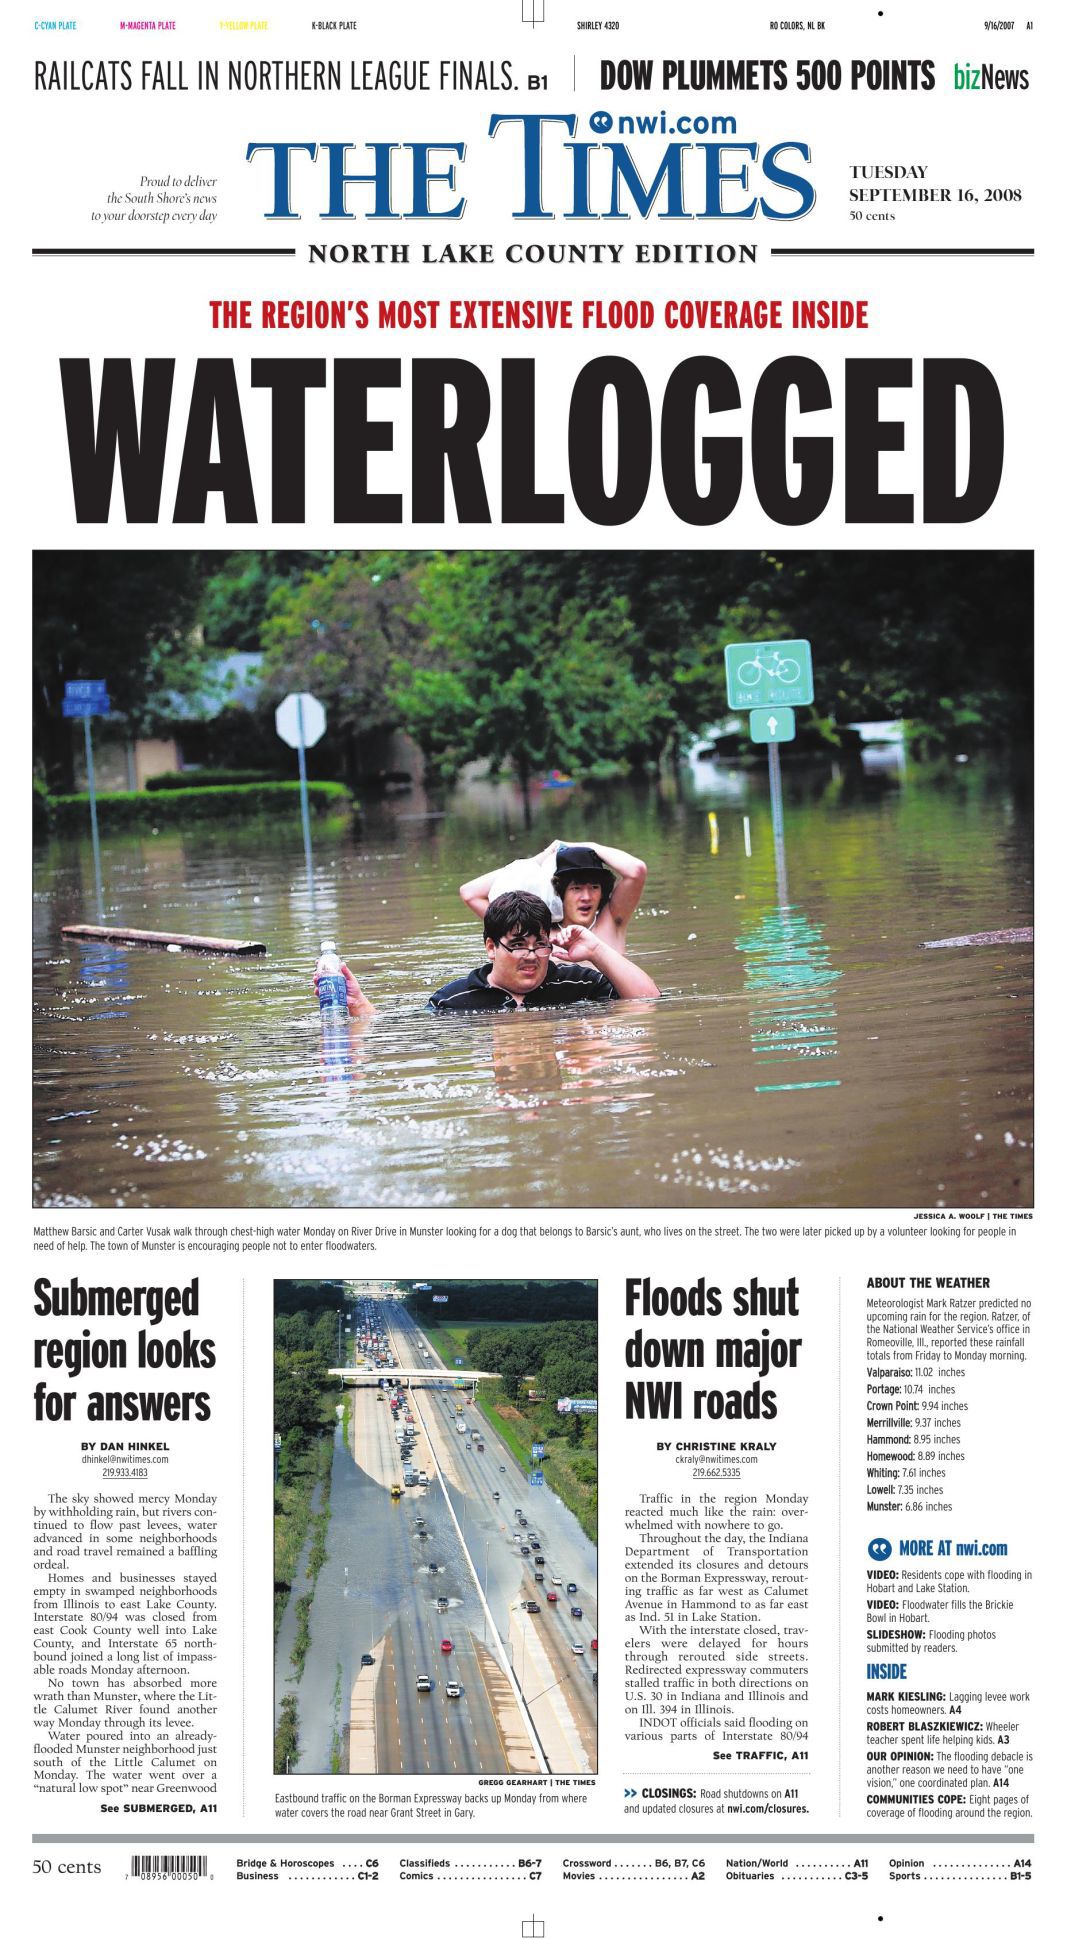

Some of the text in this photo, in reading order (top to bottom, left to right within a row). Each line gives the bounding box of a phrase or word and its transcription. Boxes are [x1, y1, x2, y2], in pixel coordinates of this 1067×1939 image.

[35, 21, 76, 30] C-CYAN PLATE
[120, 21, 175, 30] M-MAGENTA PLATE
[312, 21, 356, 30] K-BLACK PLATE
[577, 21, 619, 30] SHIRLEY 4320
[770, 21, 825, 30] RO COLORS, NL BK
[985, 21, 1033, 30] 9/16/2007 A1
[35, 61, 547, 90] RAILCATS FALL IN NORTHERN LEAGUE FINALS. B1
[601, 60, 1029, 90] DOW PLUMMETS 500 POINTS bizNews
[619, 110, 736, 134] nwi.com
[246, 111, 816, 221] THE TIMES
[850, 166, 928, 178] TUESDAY
[140, 175, 217, 187] Proud to deliver
[108, 192, 216, 204] the South Shore's news
[850, 189, 1022, 202] SEPTEMBER 16, 2008
[91, 209, 217, 224] to your doorstep every day
[850, 211, 895, 221] 50 cents
[309, 244, 757, 263] NORTH LAKE COUNTY EDITION
[209, 301, 868, 329] THE REGION'S MOST EXTENSIVE FLOOD COVERAGE INSIDE
[59, 355, 1004, 526] WATERLOGGED
[867, 1277, 990, 1288] ABOUT THE WEATHER
[34, 1277, 198, 1325] Submerged
[626, 1277, 799, 1316] Floods shut
[35, 1329, 216, 1378] region looks
[626, 1329, 802, 1377] down major
[867, 1368, 965, 1379] Valparaiso: 11.02 inches
[34, 1382, 211, 1421] for answers
[626, 1381, 777, 1419] NWI roads
[81, 1442, 169, 1451] BY DAN HINKEL
[657, 1442, 776, 1451] BY CHRISTINE KRALY
[82, 1455, 168, 1463] dhinkel@nwitimes.com
[676, 1455, 757, 1464] ckraly@nwitimes.com
[103, 1468, 147, 1476] 219.933.4183
[693, 1468, 740, 1476] 219.662.5335
[49, 1493, 217, 1505] The sky showed mercy Monday
[640, 1493, 808, 1505] Traffic in the region Monday
[900, 1540, 1007, 1556] MORE AT nwi.com
[867, 1663, 907, 1679] INSIDE
[713, 1751, 808, 1761] See TRAFFIC, A11
[642, 1788, 798, 1799] CLOSINGS: Road shutdowns on A11
[101, 1804, 216, 1813] See SUBMERGED, A11
[33, 1860, 101, 1873] 50 cents
[237, 1859, 379, 1869] Bridge & Horoscopes C6
[400, 1859, 542, 1867] Classifieds B6-7
[563, 1859, 705, 1868] Crossword B6, B7, C6
[727, 1859, 868, 1867] Nation/World A11
[889, 1859, 1031, 1868] Opinion A14
[237, 1871, 378, 1880] Business C1-2
[400, 1871, 542, 1880] Comics C7
[563, 1871, 705, 1880] Movies A2
[726, 1871, 868, 1880] Obituaries C3-5
[890, 1872, 1031, 1881] Sports B1-5
